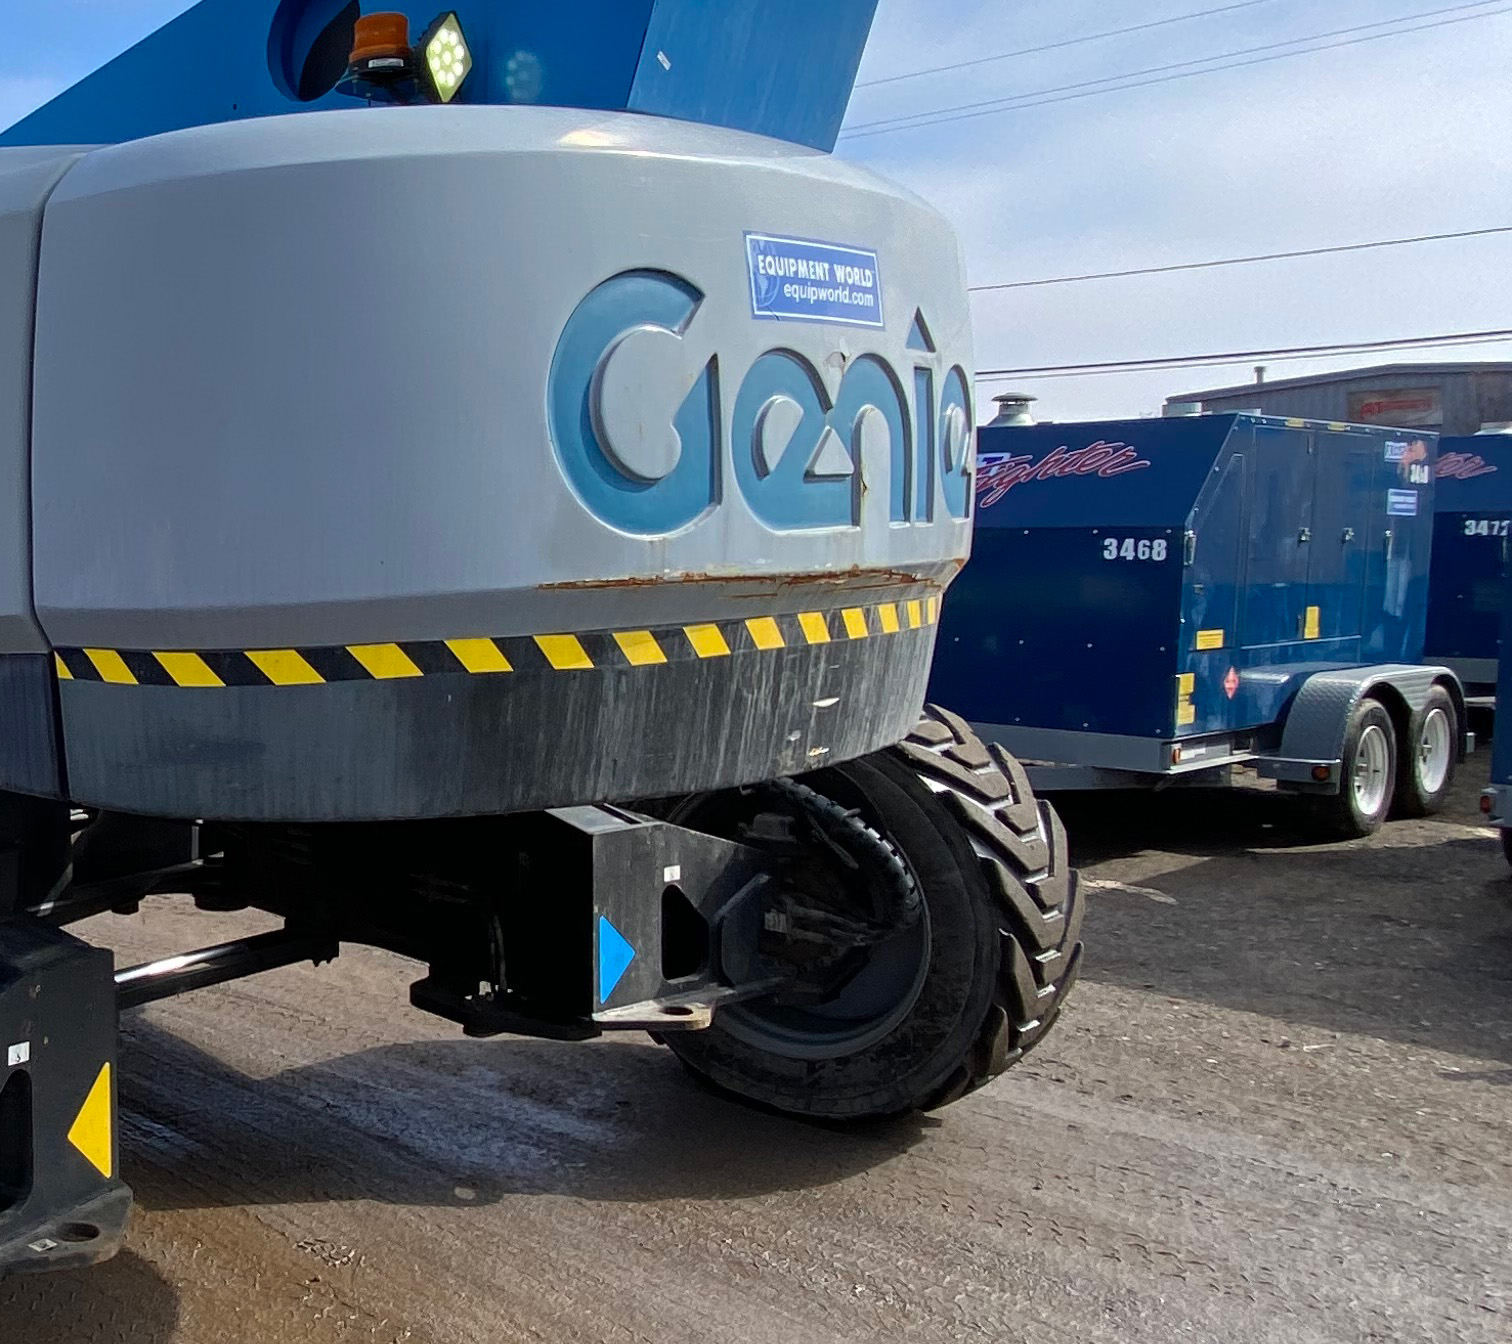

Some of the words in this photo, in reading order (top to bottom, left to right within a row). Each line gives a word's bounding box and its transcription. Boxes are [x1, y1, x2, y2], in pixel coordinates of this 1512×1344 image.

[757, 255, 830, 282] EQUIPMENT
[833, 263, 874, 288] WORLD
[783, 281, 874, 307] equipworld.com
[545, 267, 972, 541] Genie
[1103, 537, 1168, 561] 3468
